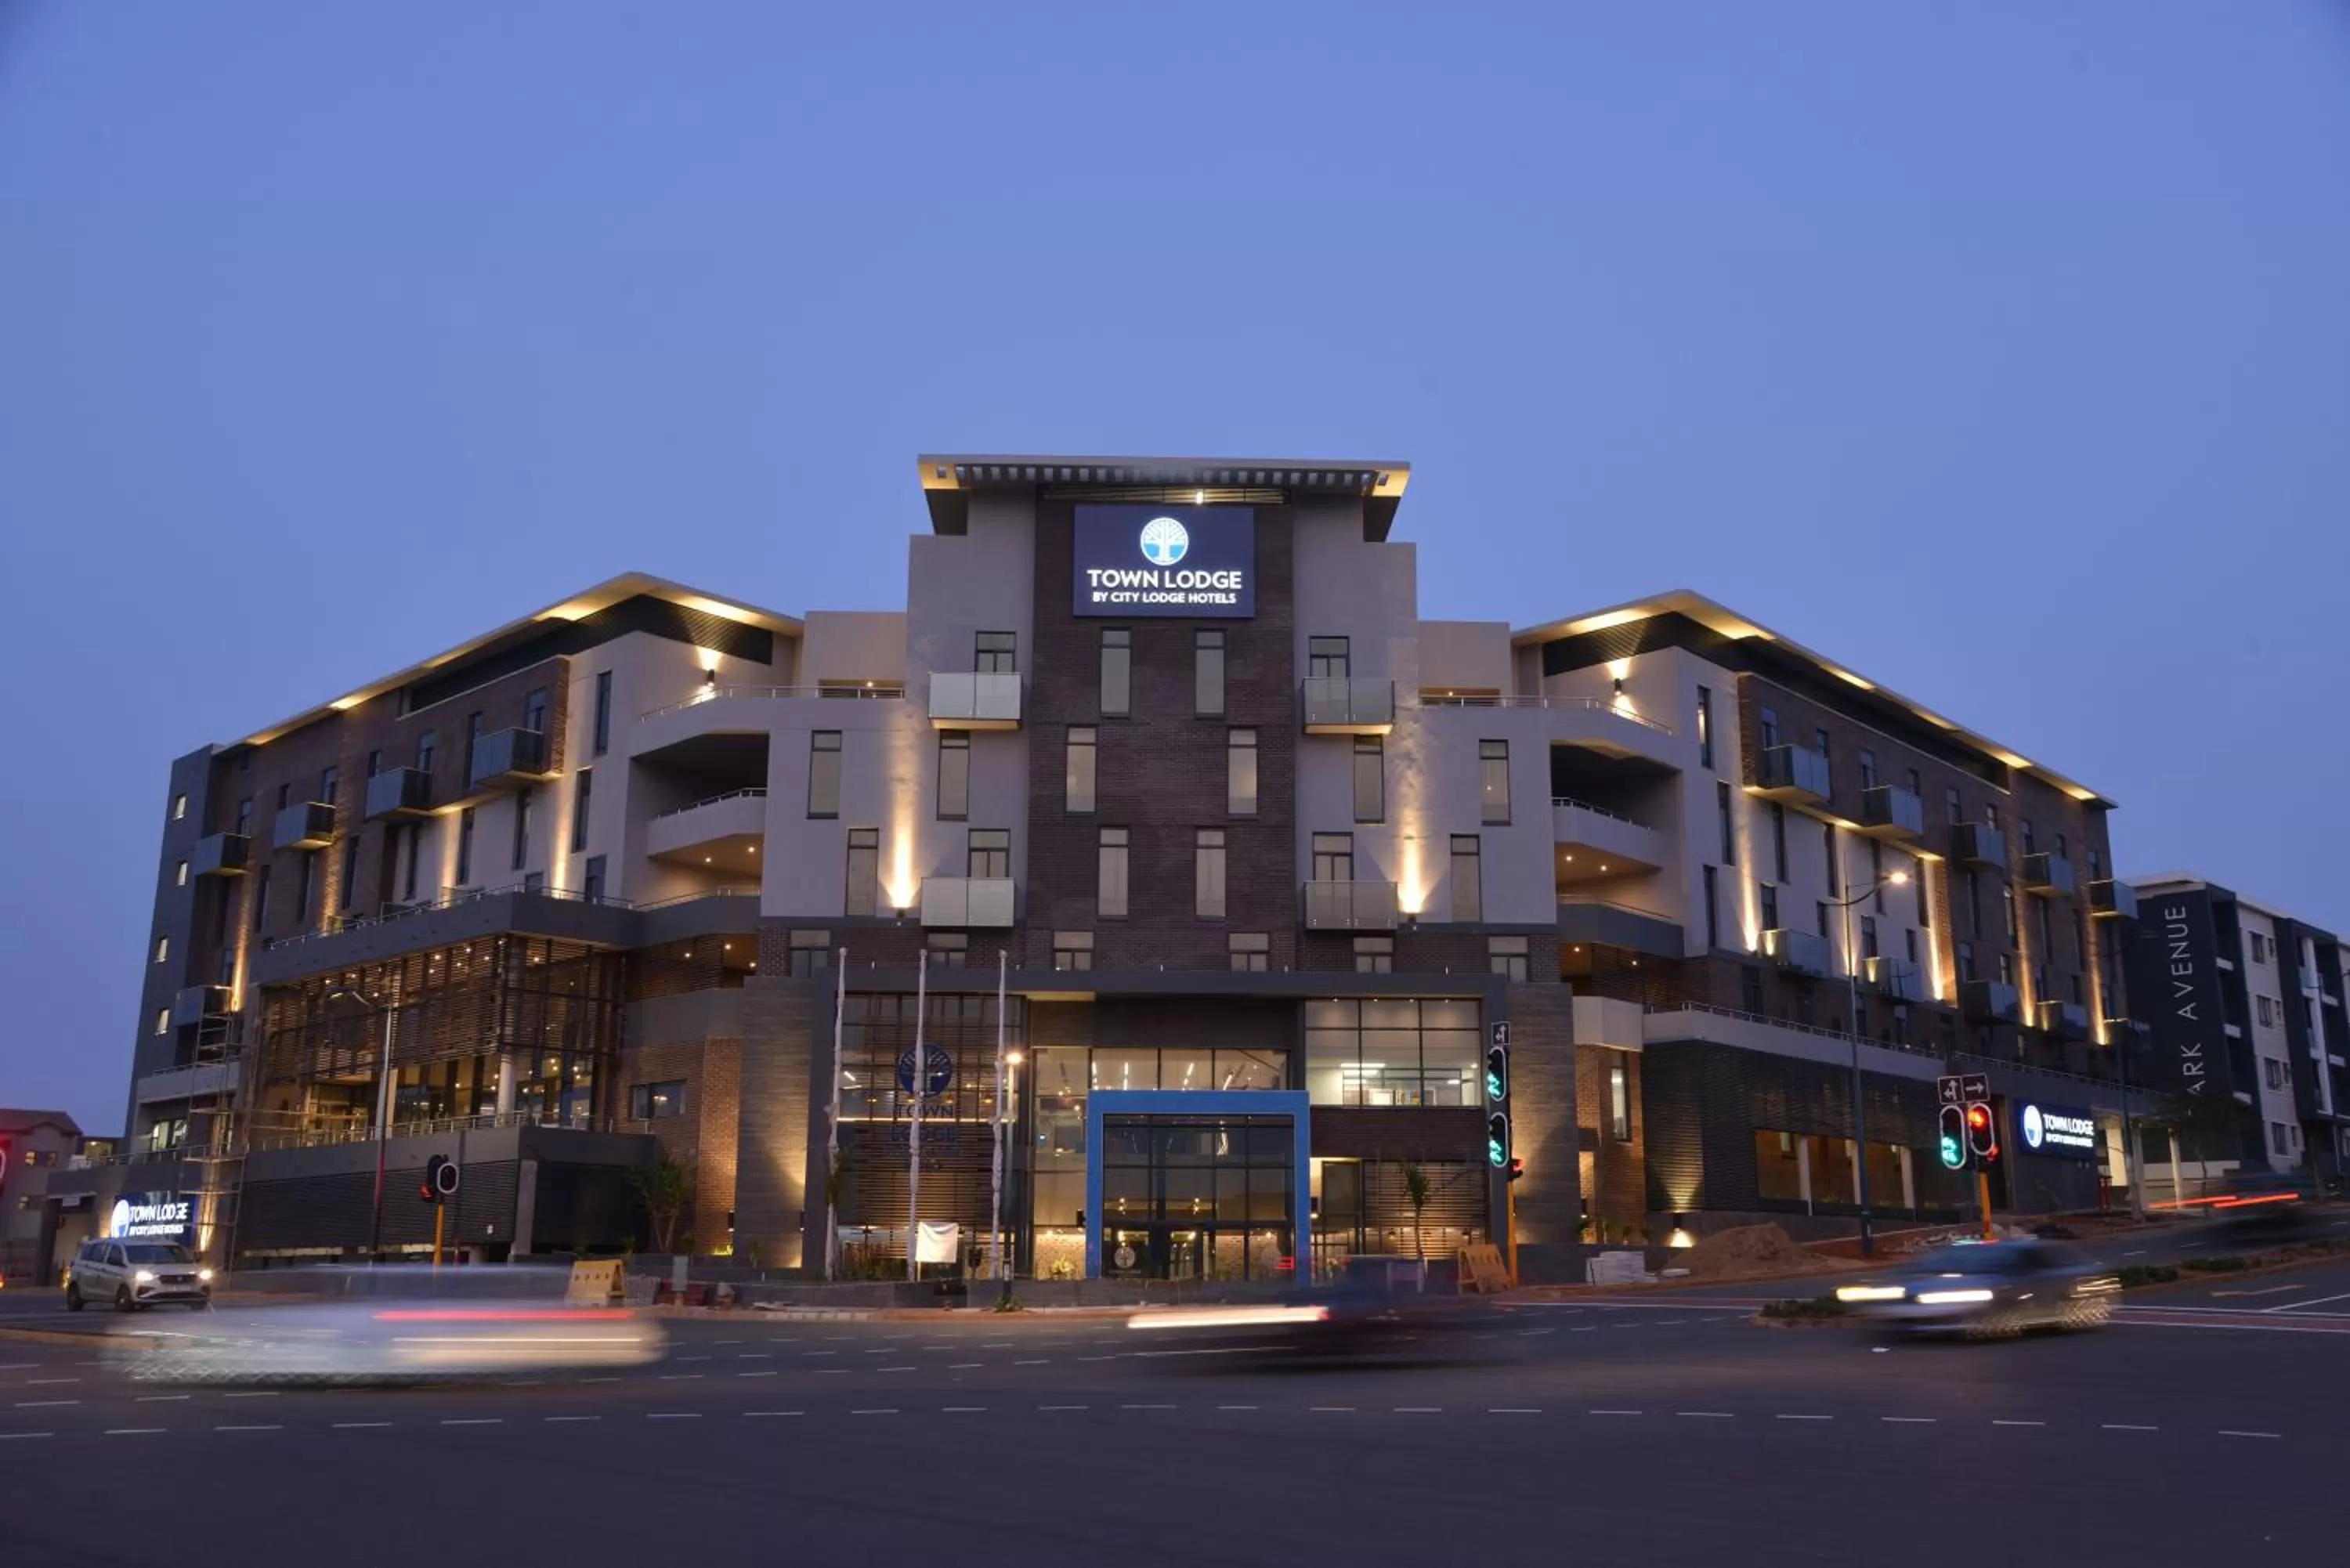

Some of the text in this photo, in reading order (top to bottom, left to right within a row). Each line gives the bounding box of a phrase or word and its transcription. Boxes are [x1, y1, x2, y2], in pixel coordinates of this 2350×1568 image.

[1086, 569, 1242, 589] TOWN LODGE
[1093, 592, 1237, 604] BY CITY LODGE HOTELS
[2164, 905, 2206, 1115] ARK AVENUE
[2043, 1114, 2094, 1136] TOWN LODGE
[129, 1205, 156, 1222] TOWN
